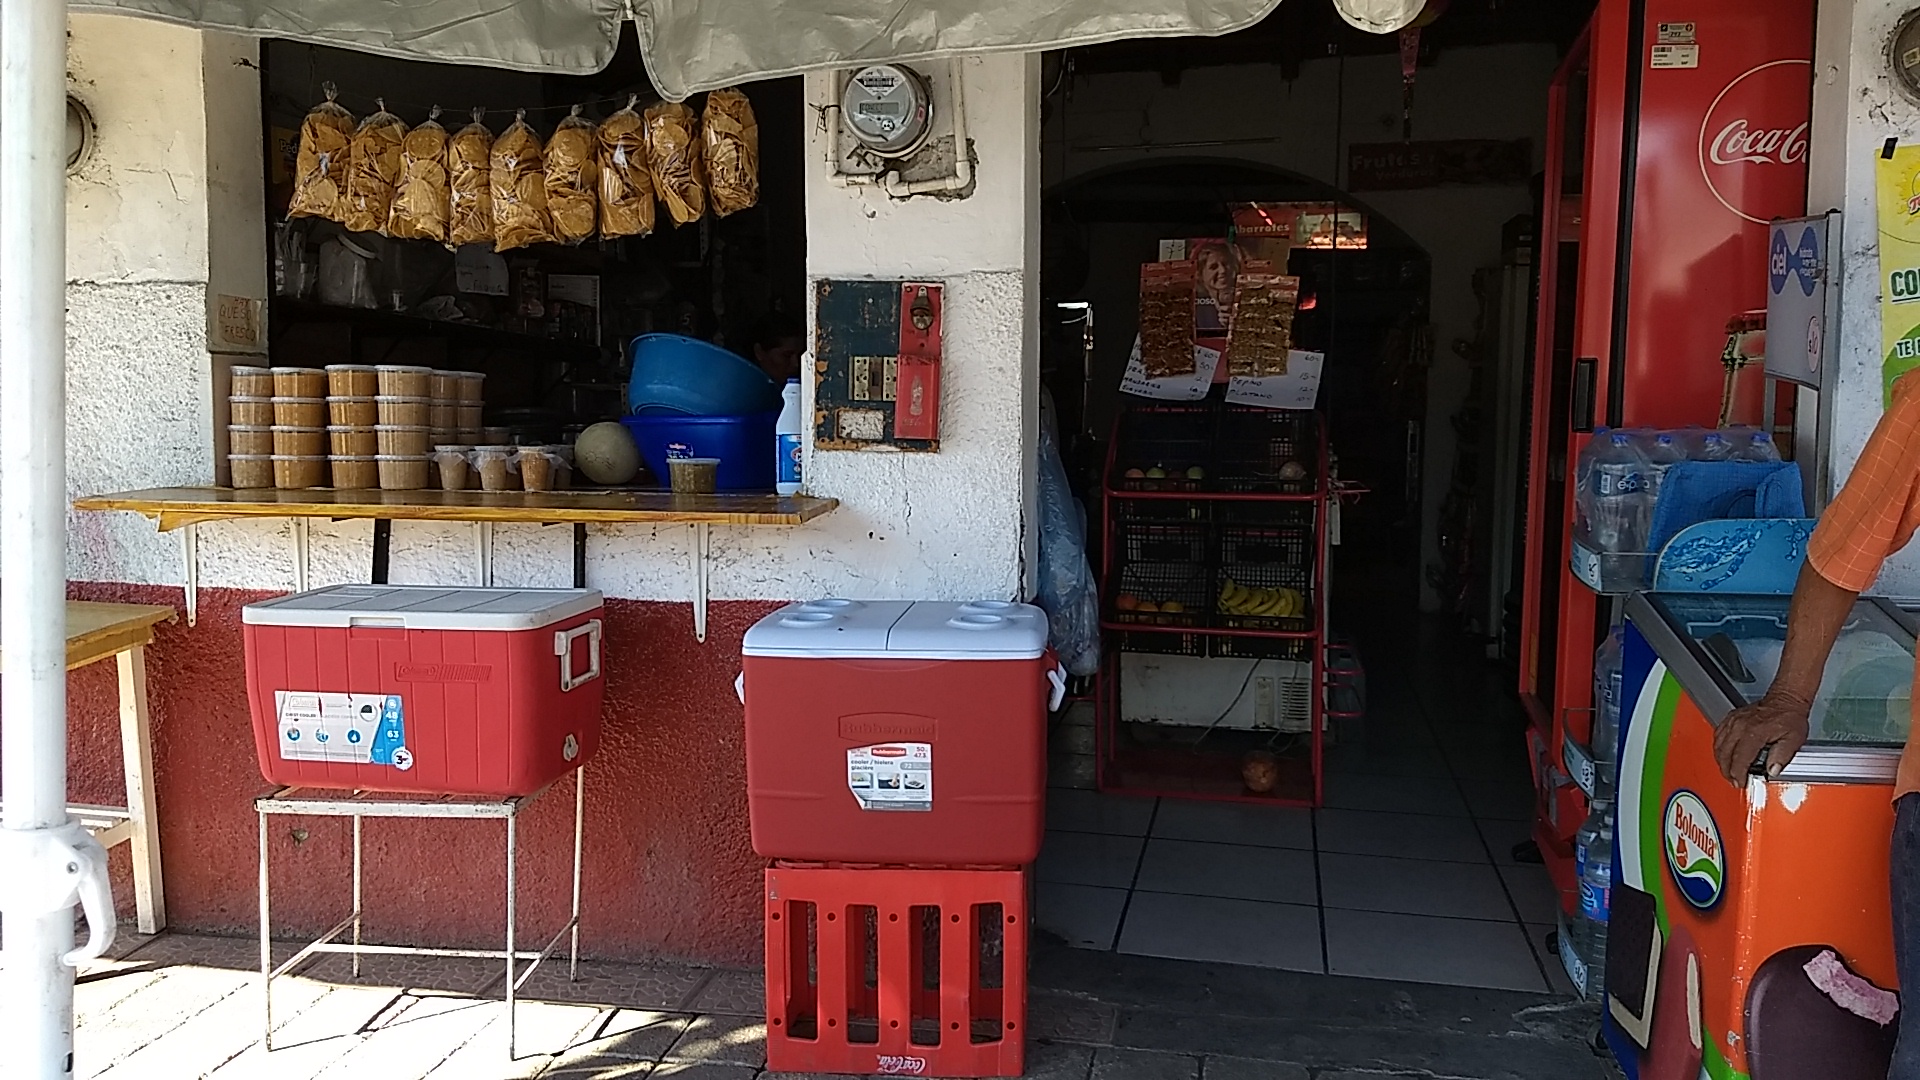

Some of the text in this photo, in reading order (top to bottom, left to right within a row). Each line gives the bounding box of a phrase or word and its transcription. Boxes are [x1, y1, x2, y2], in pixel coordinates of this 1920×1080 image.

[1771, 244, 1787, 275] ciel
[219, 304, 252, 321] QUESO
[225, 325, 256, 341] FRESCO
[1896, 341, 1911, 356] TE
[385, 711, 398, 719] 48
[386, 730, 399, 738] 63
[1674, 801, 1716, 861] Bolonia
